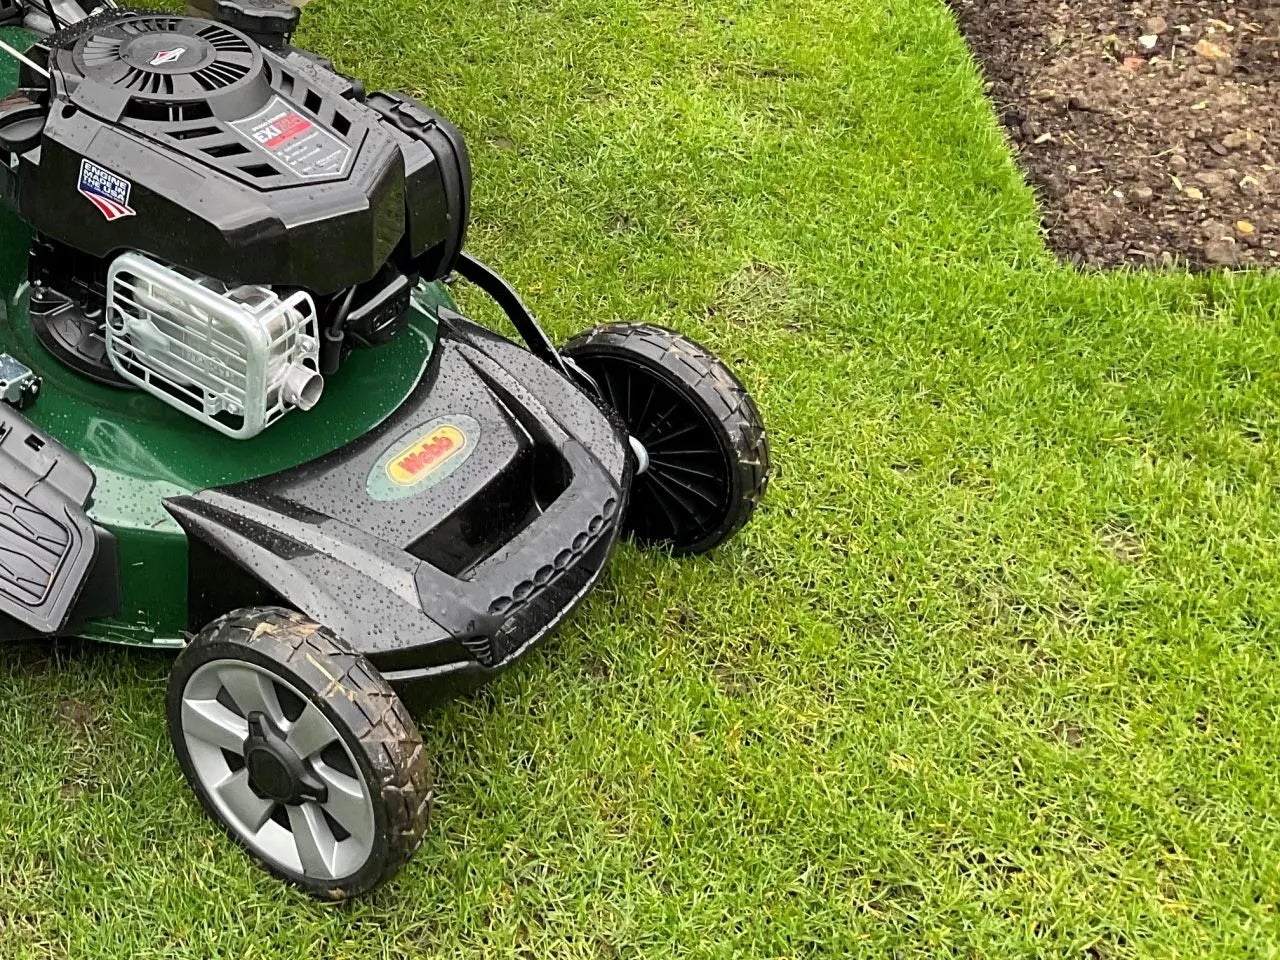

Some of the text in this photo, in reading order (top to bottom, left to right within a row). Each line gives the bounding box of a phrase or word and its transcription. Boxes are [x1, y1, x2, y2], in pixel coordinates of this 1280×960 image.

[83, 169, 112, 188] MADE
[114, 185, 126, 196] IN
[83, 175, 101, 188] THE
[103, 185, 124, 201] USA
[84, 162, 127, 190] ENGINE
[398, 436, 454, 475] Webb
